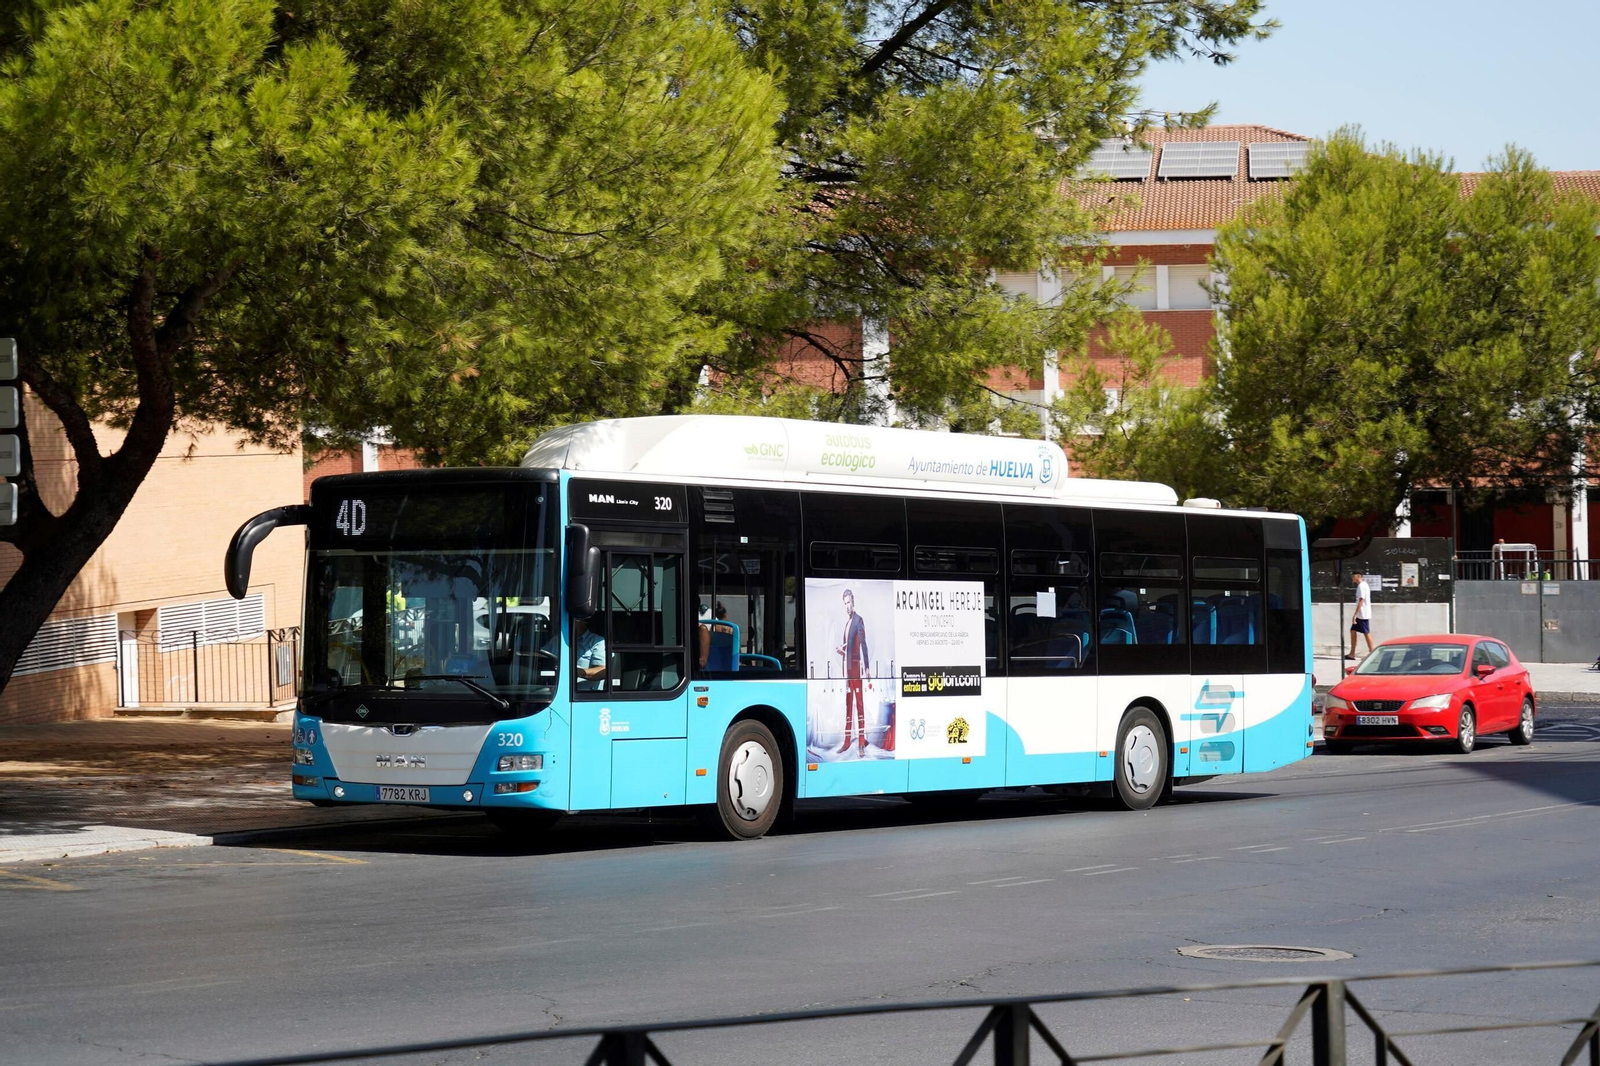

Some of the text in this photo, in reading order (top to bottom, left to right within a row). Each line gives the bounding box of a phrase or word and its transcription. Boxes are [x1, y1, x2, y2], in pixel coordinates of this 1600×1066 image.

[759, 443, 785, 457] GNC
[908, 456, 1034, 479] Ayuntamiento de HUELVA
[588, 493, 615, 504] MAN
[654, 496, 672, 511] 320
[336, 499, 366, 536] 4D
[949, 591, 981, 611] HEREJE
[903, 682, 921, 693] entrada
[927, 671, 981, 692] giglon.com
[1361, 716, 1397, 725] 8302 HVN
[498, 732, 524, 748] 320
[376, 754, 427, 768] MAN
[382, 787, 427, 801] 7782 KRJ
